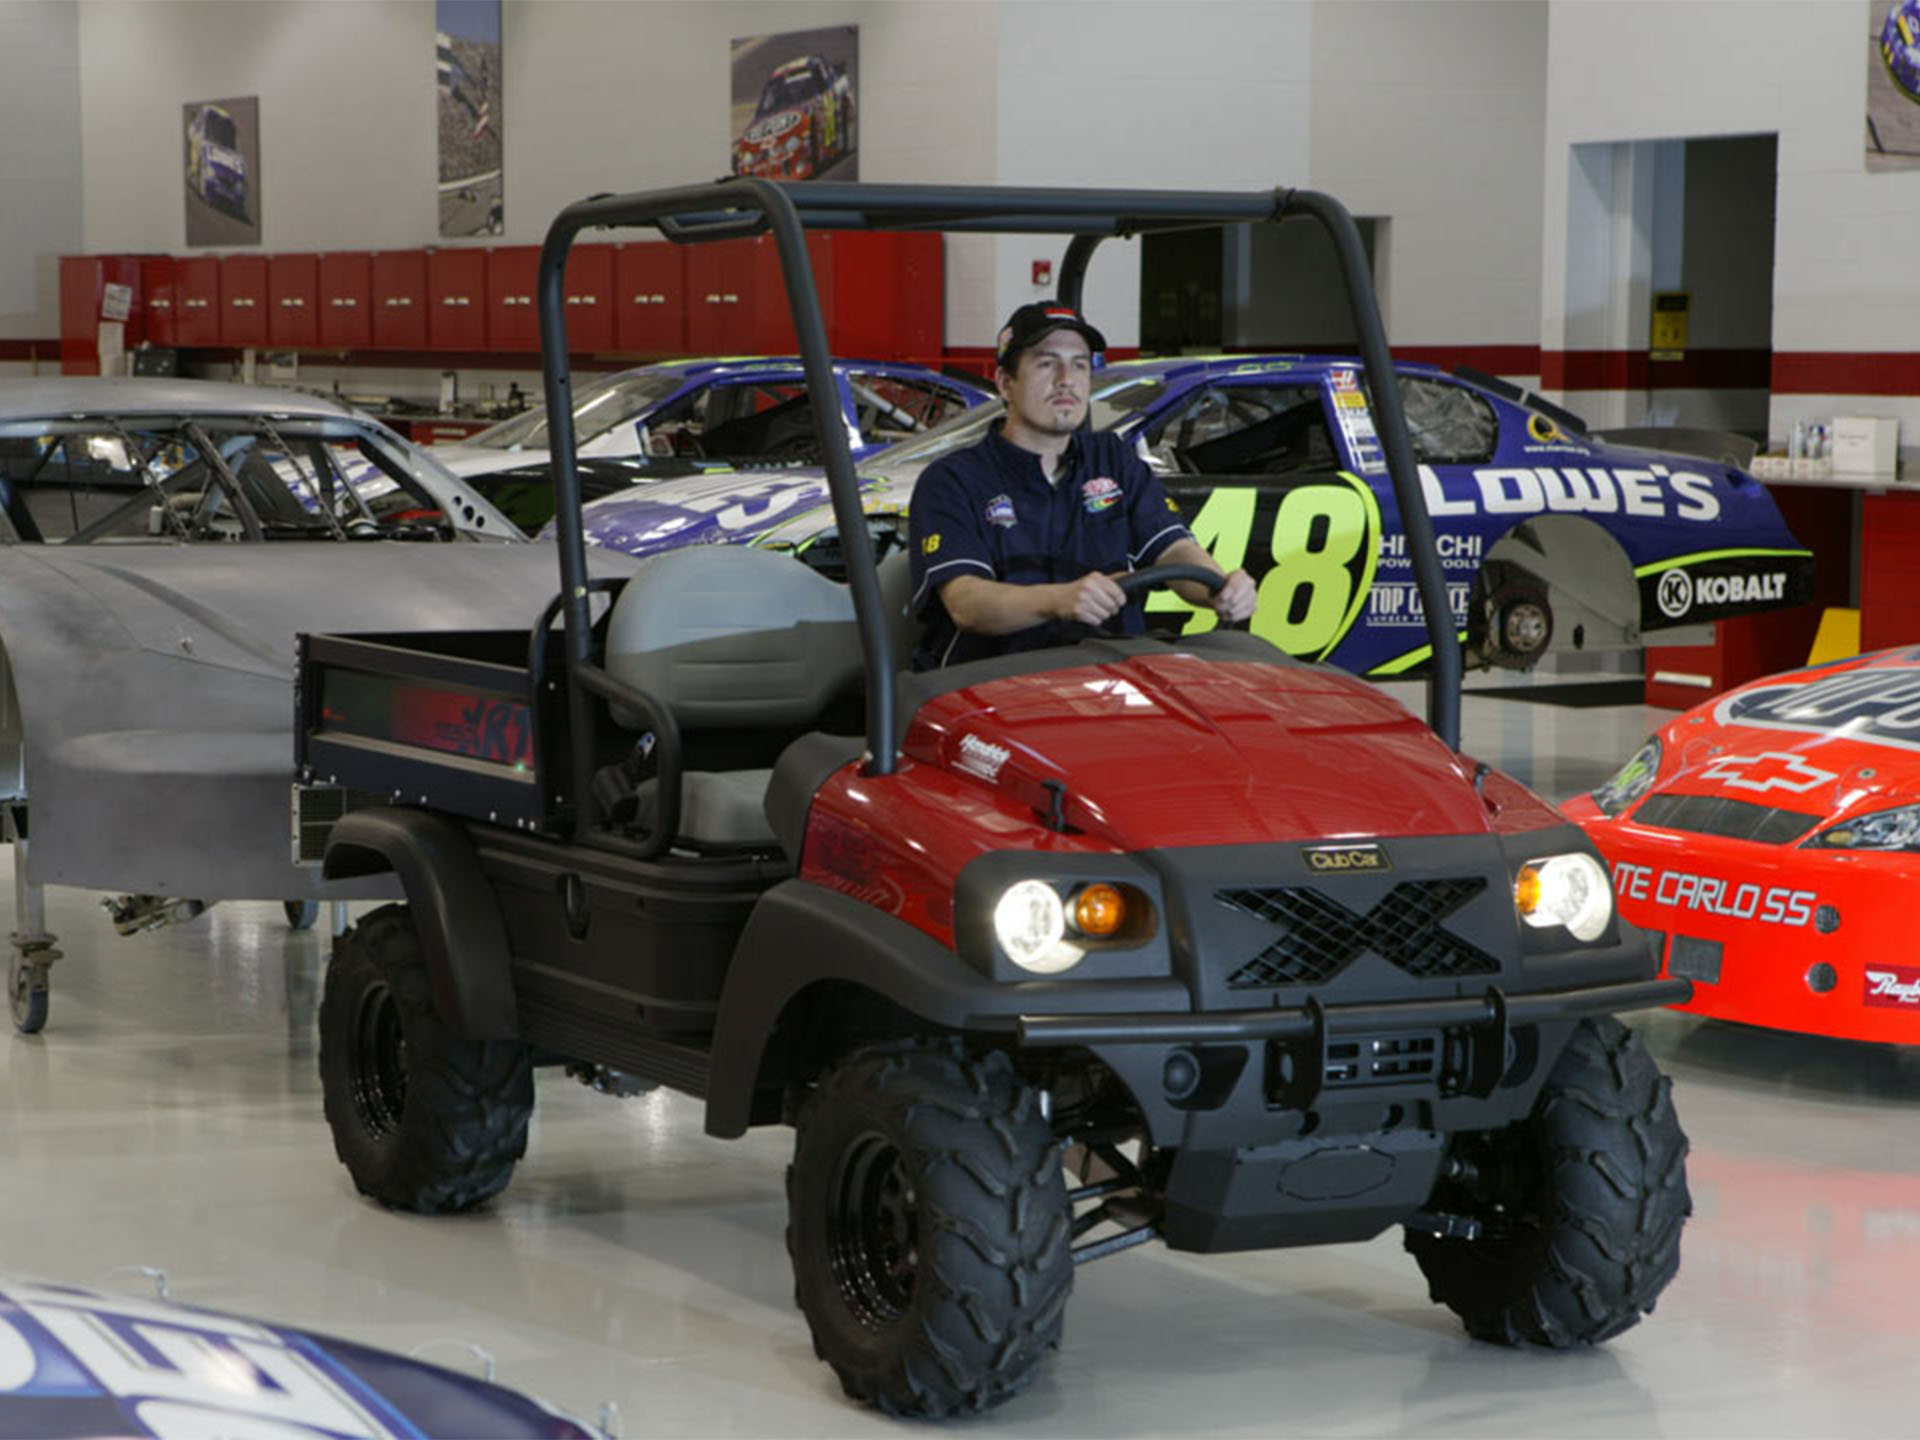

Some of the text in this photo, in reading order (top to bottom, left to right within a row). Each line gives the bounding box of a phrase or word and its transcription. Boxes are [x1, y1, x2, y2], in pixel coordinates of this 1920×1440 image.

[1417, 463, 1720, 521] LOWE'S
[1378, 535, 1482, 557] HICHI
[1442, 559, 1480, 569] OOLS
[1371, 587, 1404, 614] TOP
[1696, 573, 1787, 605] KOBALT
[1655, 871, 1761, 919] CARLO
[1760, 888, 1817, 926] SS
